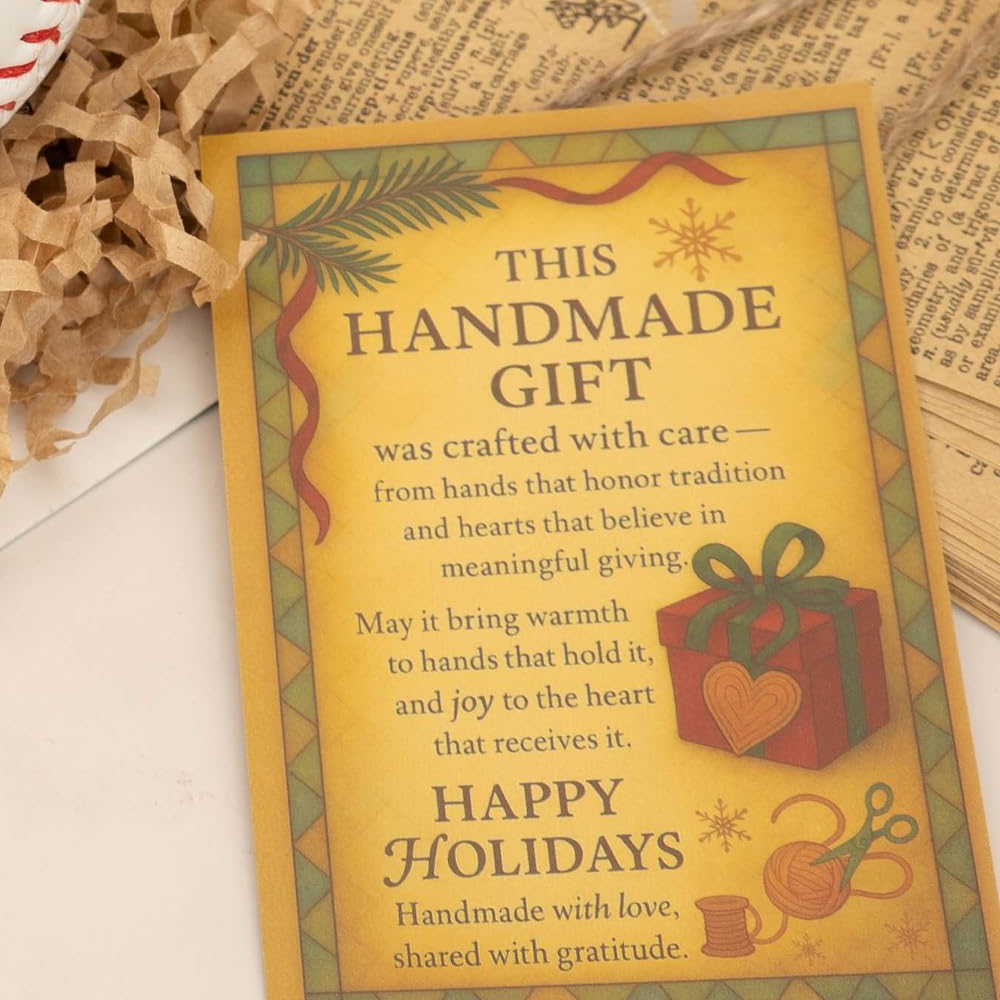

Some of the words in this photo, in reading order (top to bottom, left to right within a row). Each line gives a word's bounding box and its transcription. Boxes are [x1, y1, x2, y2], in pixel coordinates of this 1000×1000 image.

[324, 94, 342, 112] to
[338, 60, 363, 92] give
[358, 4, 394, 57] oneself
[331, 51, 349, 72] on
[489, 32, 530, 90] carriage
[752, 43, 773, 65] by
[761, 43, 793, 84] which
[792, 34, 818, 64] that
[811, 34, 838, 65] that
[823, 47, 852, 84] extra
[846, 15, 869, 39] tax
[930, 38, 955, 72] over
[659, 75, 676, 93] to
[697, 77, 714, 94] to
[894, 187, 935, 250] examine
[931, 167, 946, 184] or
[942, 101, 980, 164] consider
[975, 83, 992, 100] in
[913, 232, 932, 249] 2.
[926, 209, 944, 227] to
[938, 130, 987, 204] determine
[933, 233, 952, 253] of
[947, 209, 967, 227] (a
[960, 164, 989, 200] tract
[495, 243, 617, 282] THIS
[945, 244, 968, 274] and
[343, 285, 782, 356] HANDMADE
[922, 344, 937, 360] n.
[930, 278, 973, 340] (usually
[939, 348, 957, 368] as
[948, 322, 970, 346] by
[957, 355, 974, 374] or
[490, 357, 652, 408] GIFT
[374, 440, 433, 463] was
[443, 425, 560, 458] crafted
[569, 421, 649, 451] with
[374, 477, 435, 503] from
[442, 474, 518, 500] hands
[526, 472, 577, 495] that
[583, 469, 661, 492] honor
[669, 461, 786, 487] tradition
[403, 517, 449, 541] and
[458, 512, 536, 538] hearts
[542, 511, 594, 534] that
[599, 506, 692, 531] believe
[699, 504, 727, 525] in
[440, 548, 589, 581] meaningful
[599, 544, 689, 577] giving.
[355, 611, 413, 641] May
[421, 610, 439, 632] it
[447, 607, 520, 636] bring
[526, 599, 629, 628] warmth
[388, 654, 413, 674] to
[420, 647, 498, 673] hands
[505, 645, 556, 670] that
[563, 642, 622, 666] hold
[629, 640, 654, 666] it,
[396, 690, 443, 717] and
[450, 689, 494, 723] joy
[503, 693, 529, 711] to
[536, 685, 578, 709] the
[585, 683, 656, 706] heart
[434, 731, 487, 757] that
[494, 728, 598, 754] receives
[605, 725, 632, 749] it.
[431, 778, 624, 822] HAPPY
[382, 831, 684, 888] HOLIDAYS
[395, 897, 545, 926] Handmade
[552, 894, 611, 920] with
[618, 892, 679, 920] love,
[394, 941, 481, 970] shared
[488, 939, 549, 966] with
[557, 934, 688, 972] gratitude.
